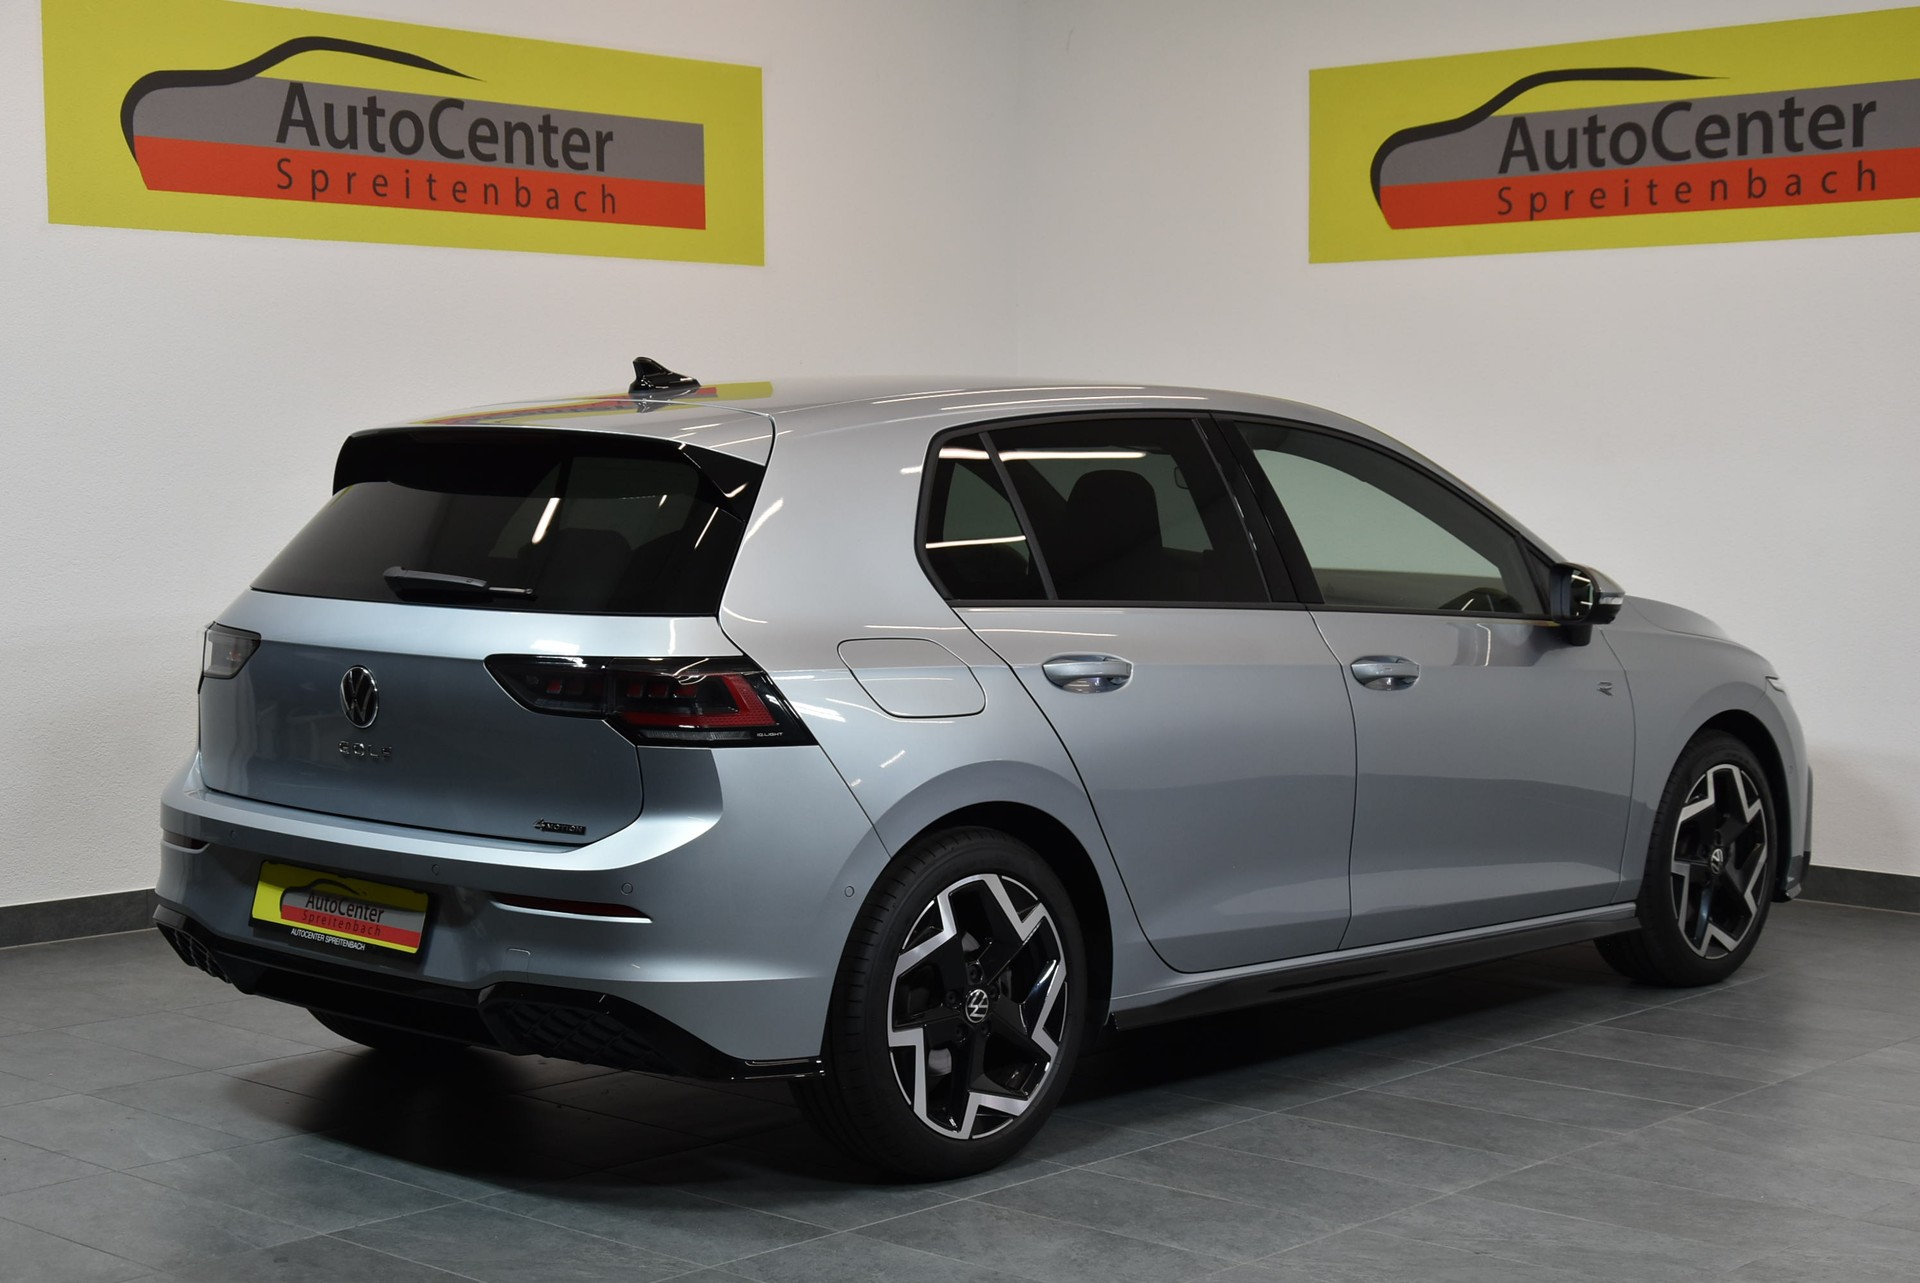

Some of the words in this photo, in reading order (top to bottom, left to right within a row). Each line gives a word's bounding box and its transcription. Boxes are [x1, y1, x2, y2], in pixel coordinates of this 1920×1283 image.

[276, 81, 614, 172] AutoCenter
[1498, 96, 1877, 175] AutoCenter
[276, 157, 616, 214] Spreitenbach
[1497, 159, 1877, 220] Spreitenbach
[338, 740, 392, 758] GOLF
[302, 909, 381, 937] Spreitenbach
[305, 893, 385, 923] AutoCenter
[290, 927, 325, 942] AUTOCENTER
[325, 935, 365, 950] SPREITENBACH
